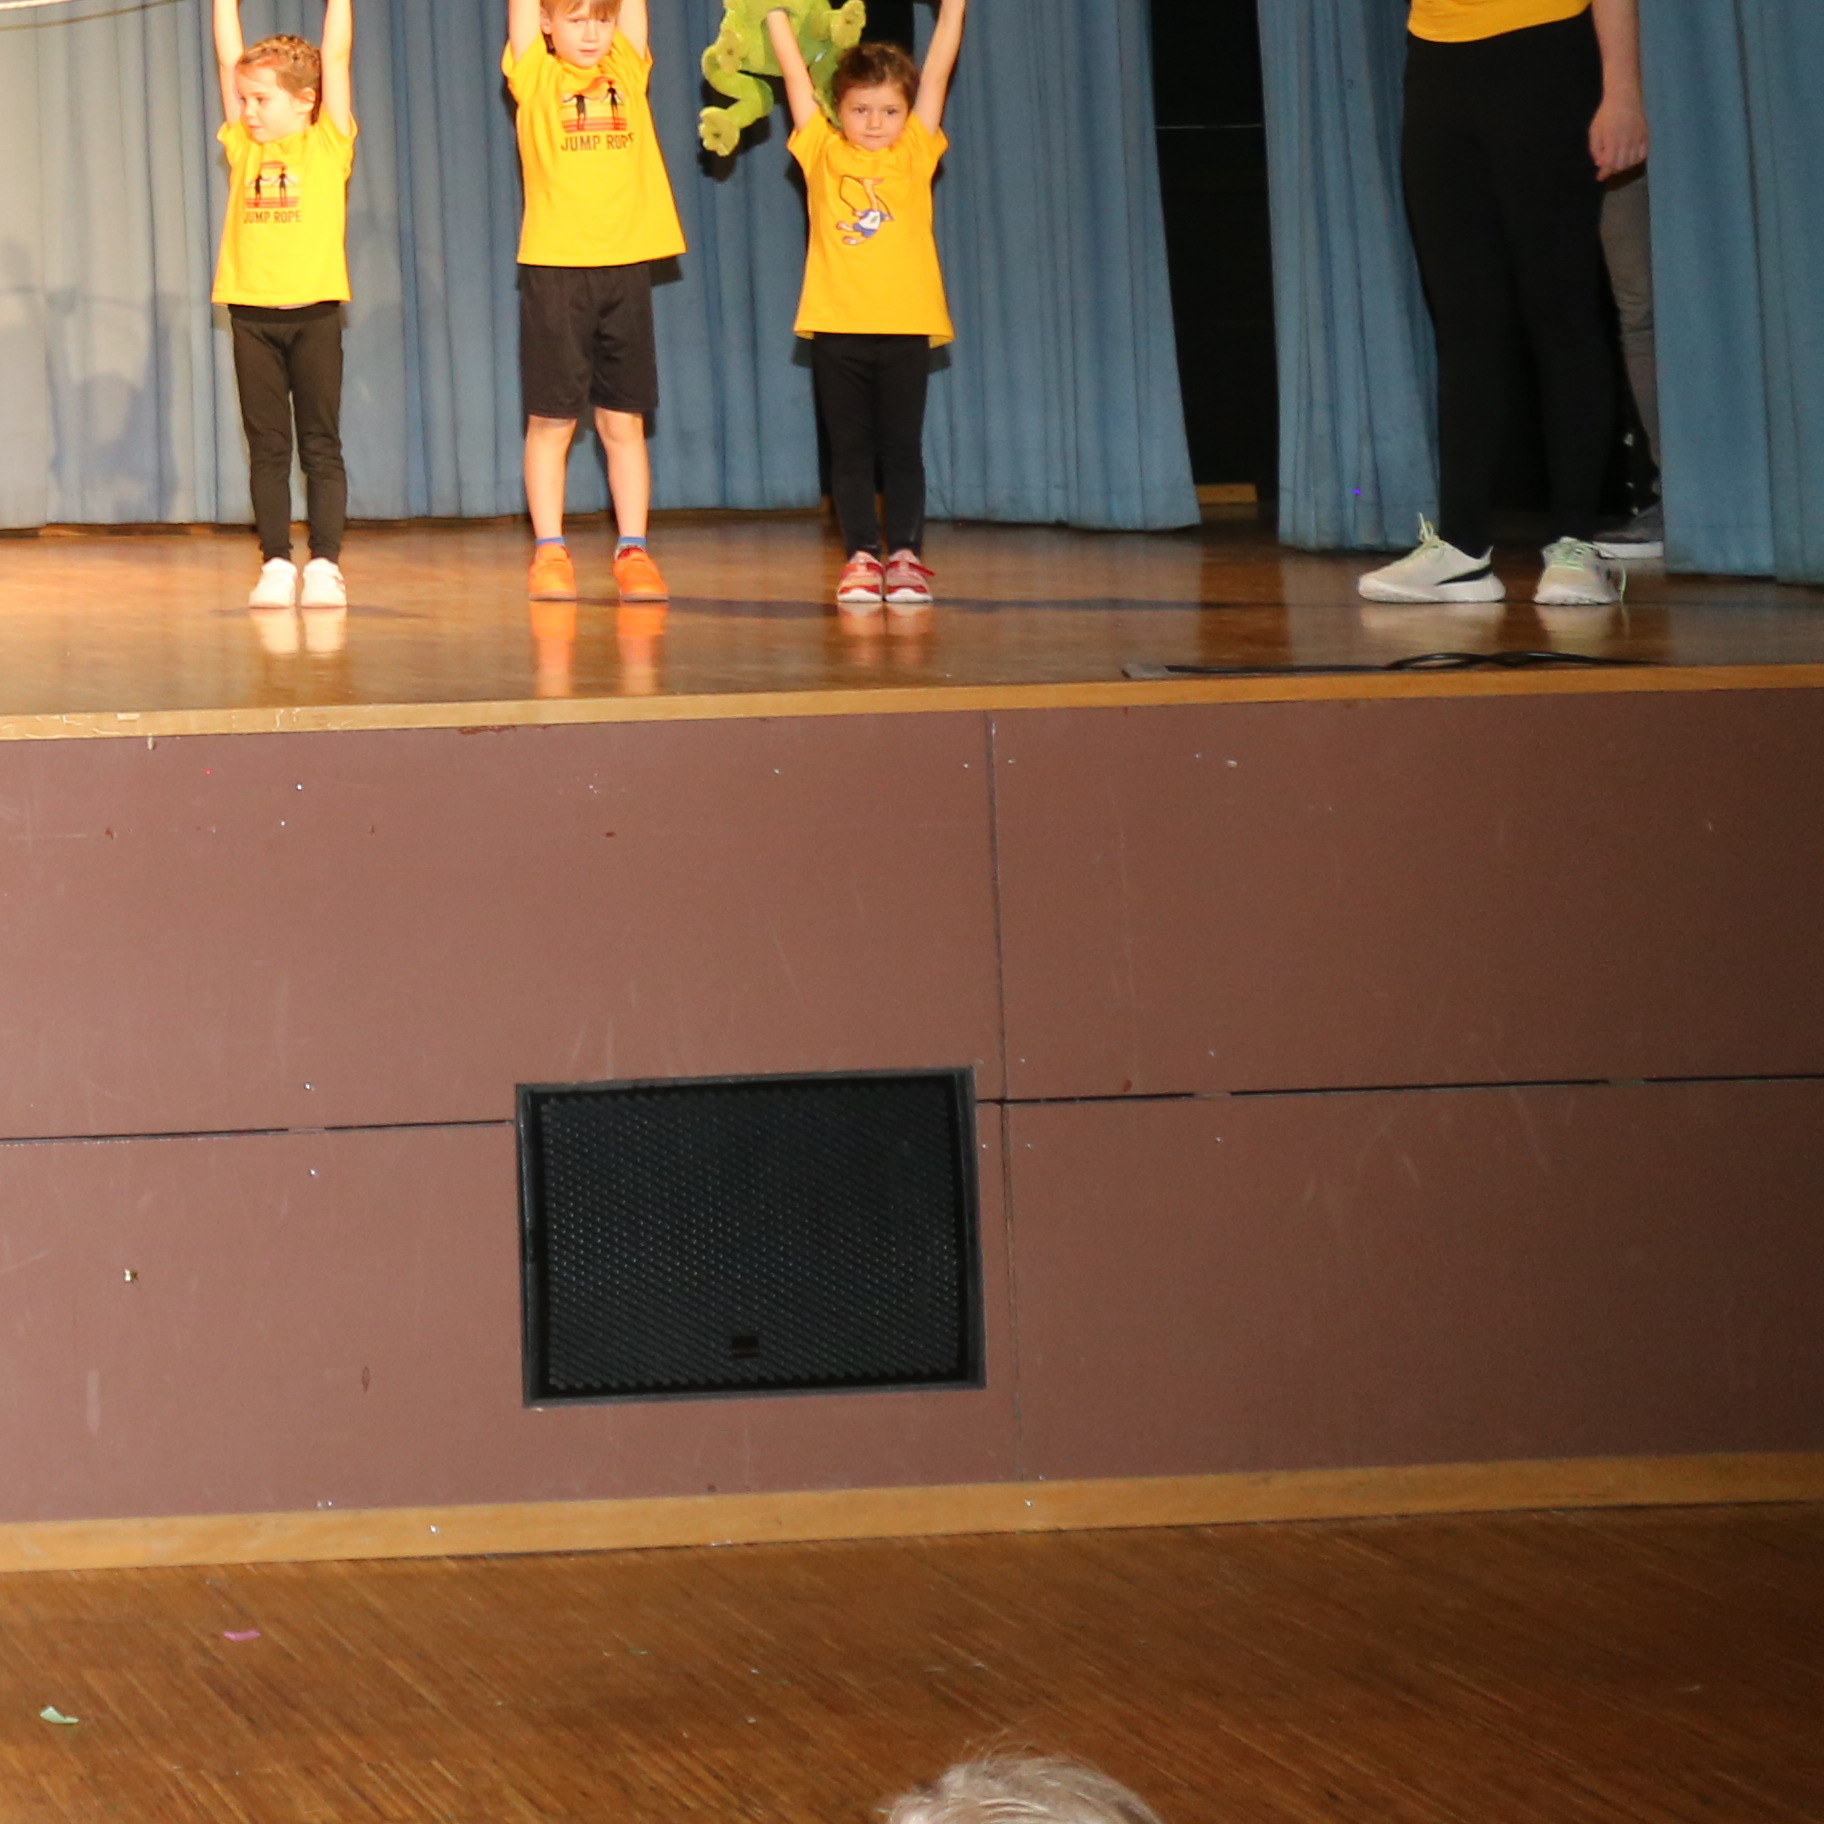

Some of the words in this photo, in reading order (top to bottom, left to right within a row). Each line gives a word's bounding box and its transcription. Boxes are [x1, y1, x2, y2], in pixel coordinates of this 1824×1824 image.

[560, 134, 601, 151] JUMP
[243, 210, 271, 224] JUMP
[273, 209, 302, 224] ROPE
